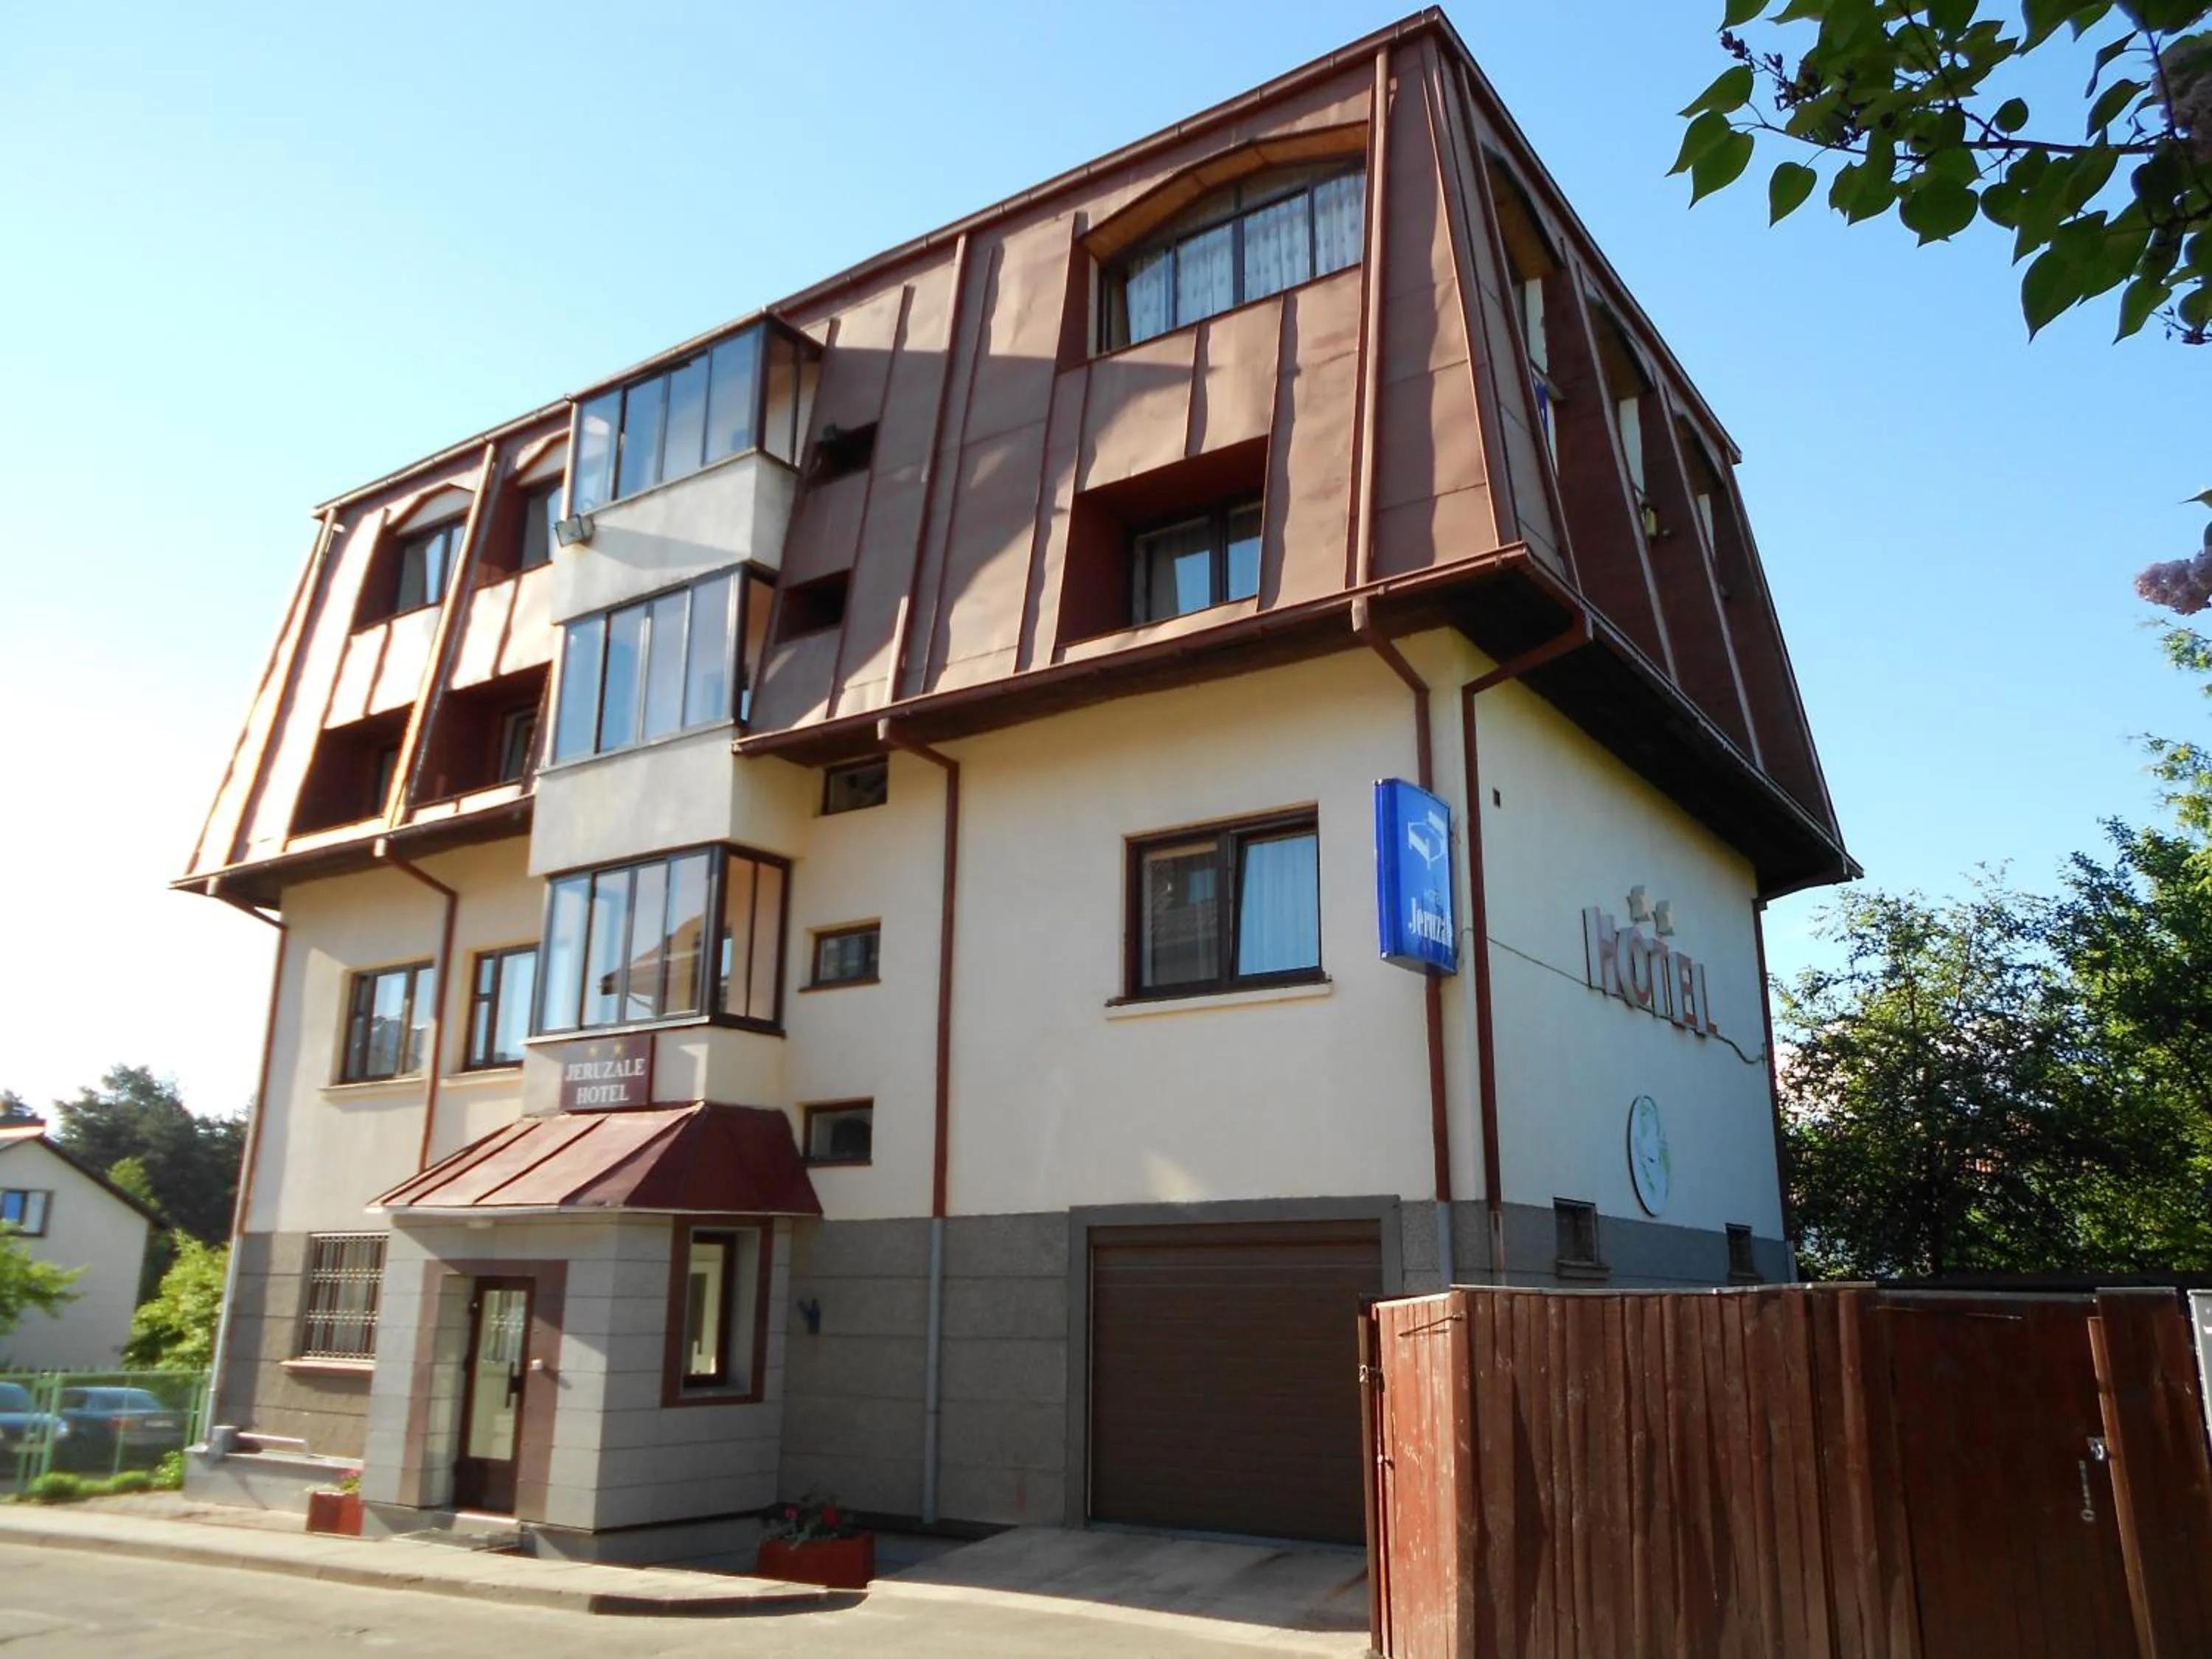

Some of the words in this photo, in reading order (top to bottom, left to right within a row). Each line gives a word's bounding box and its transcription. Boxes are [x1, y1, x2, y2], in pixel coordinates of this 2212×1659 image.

[1582, 906, 1718, 1036] HOTEL
[566, 1058, 646, 1081] JERUZALE
[575, 1084, 630, 1105] HOTEL
